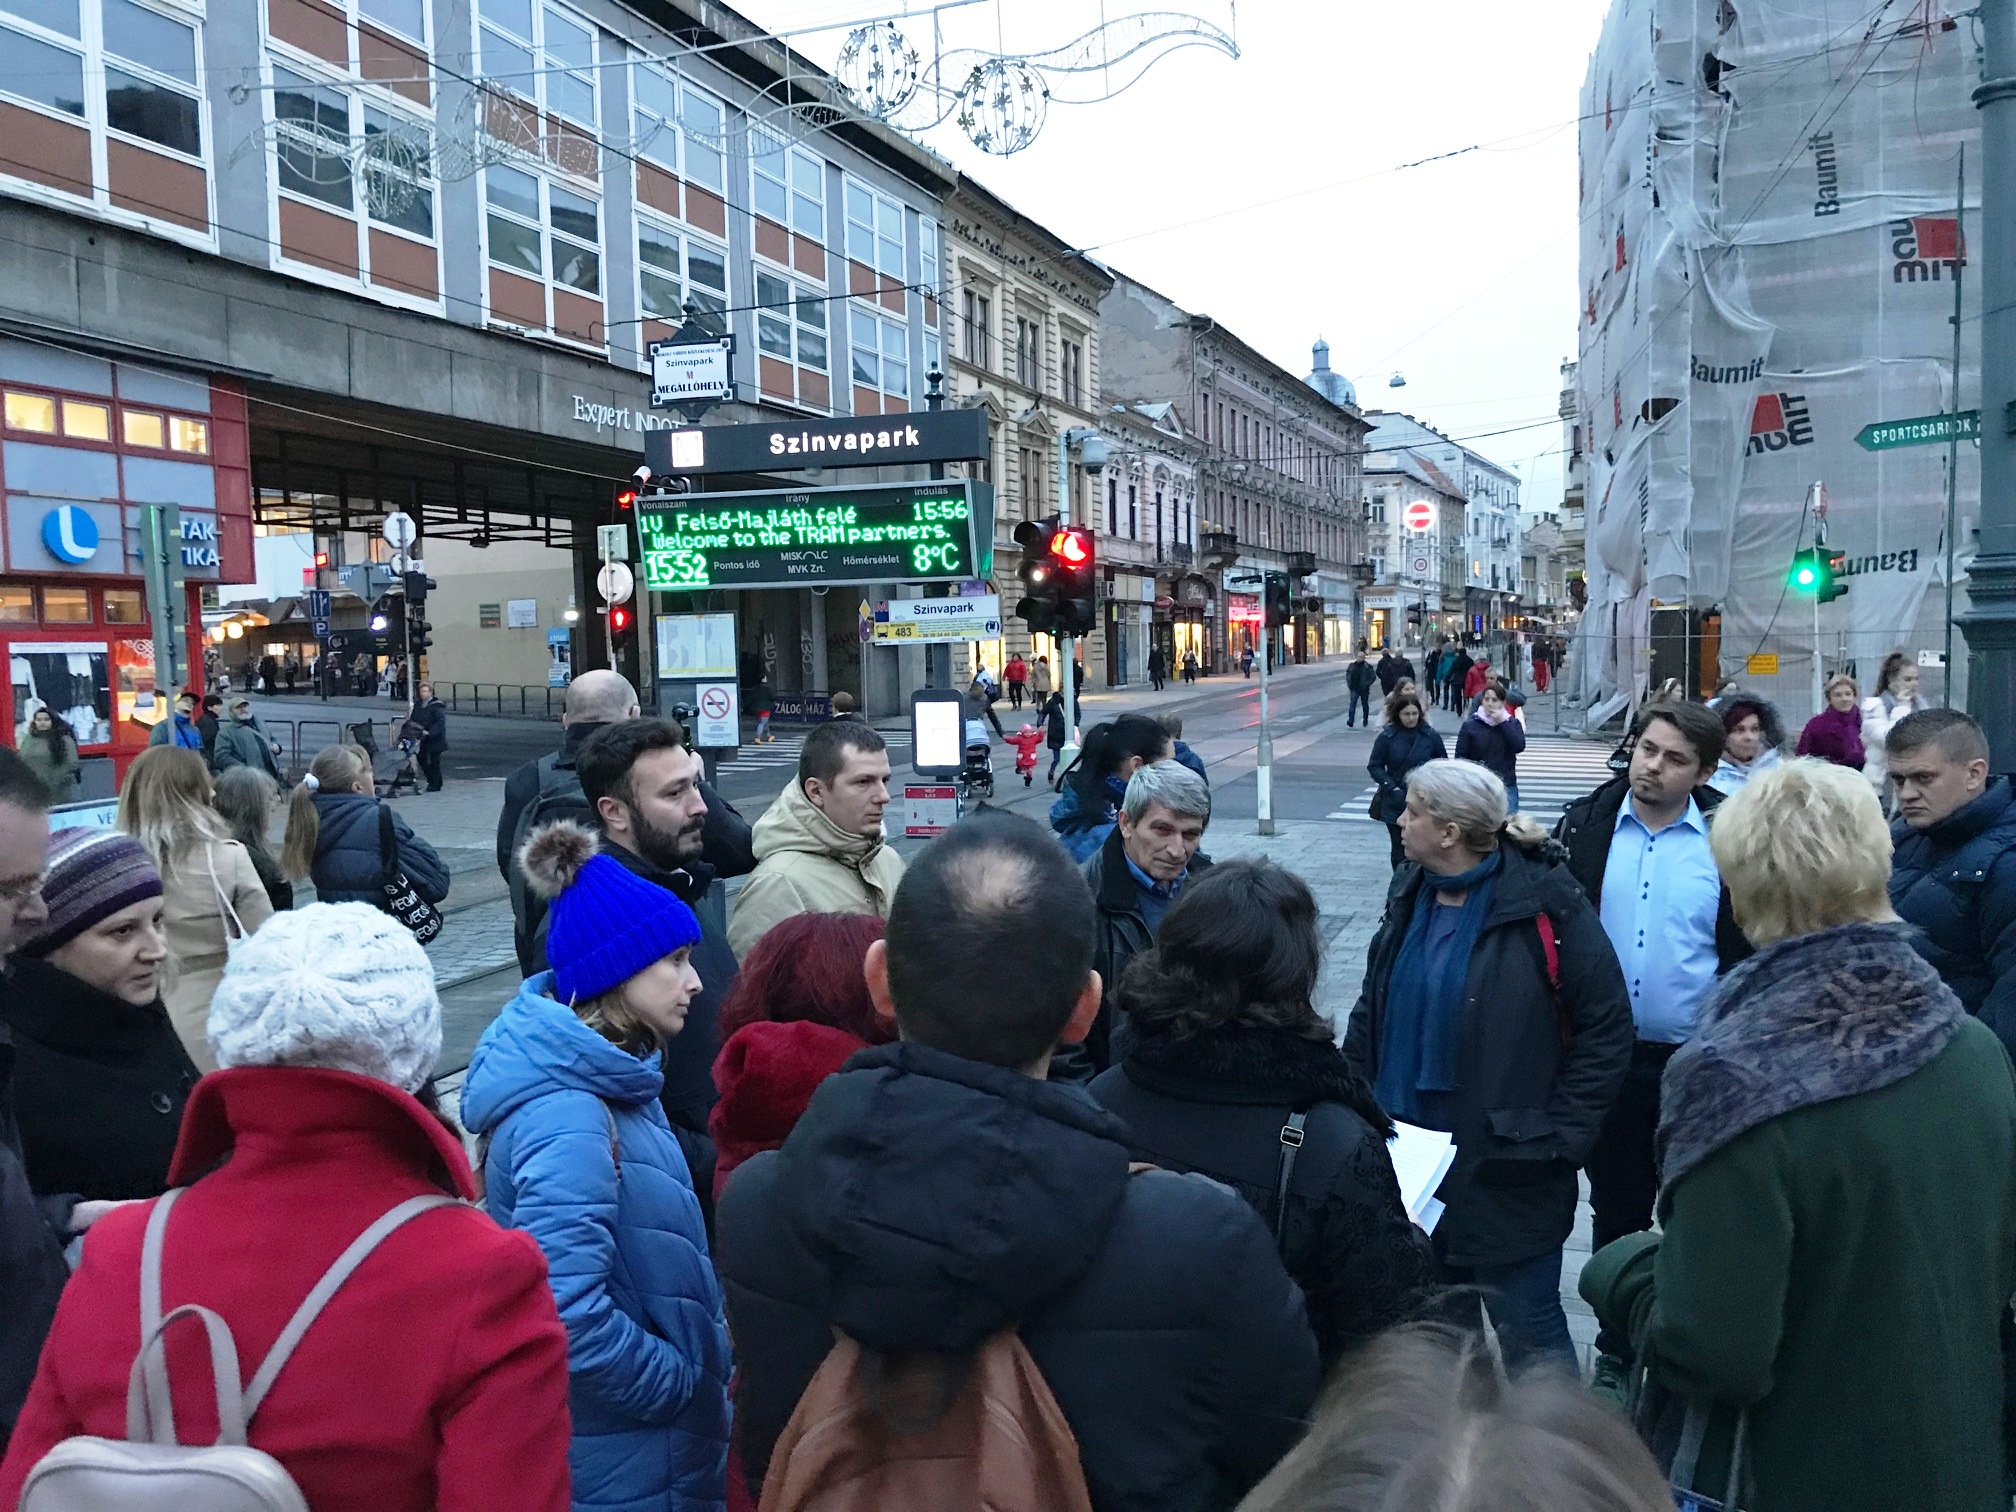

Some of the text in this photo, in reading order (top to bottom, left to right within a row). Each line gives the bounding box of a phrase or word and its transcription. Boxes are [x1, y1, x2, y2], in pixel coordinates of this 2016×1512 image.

[1808, 131, 1840, 217] Baumit
[666, 356, 714, 368] Szinvapark
[658, 381, 725, 394] MEGÁLLÓHELY
[572, 395, 631, 433] Expert
[769, 424, 920, 455] Szinvapark
[641, 500, 688, 510] Vonalszám
[676, 508, 813, 532] Felső-Majláth
[815, 505, 858, 525] felé
[913, 500, 969, 521] 15:56
[179, 516, 215, 541] TÁK
[652, 523, 951, 550] Welcome to the TRAM partners.
[843, 554, 900, 566] Hőmérséklet
[913, 542, 960, 572] 8°C
[713, 559, 761, 571] Pontos idő
[787, 563, 826, 574] MVK Zrt.
[913, 602, 975, 616] Szinvapark
[895, 627, 912, 638] 483
[774, 701, 801, 715] ZÁLOG
[806, 702, 825, 715] HÁZ
